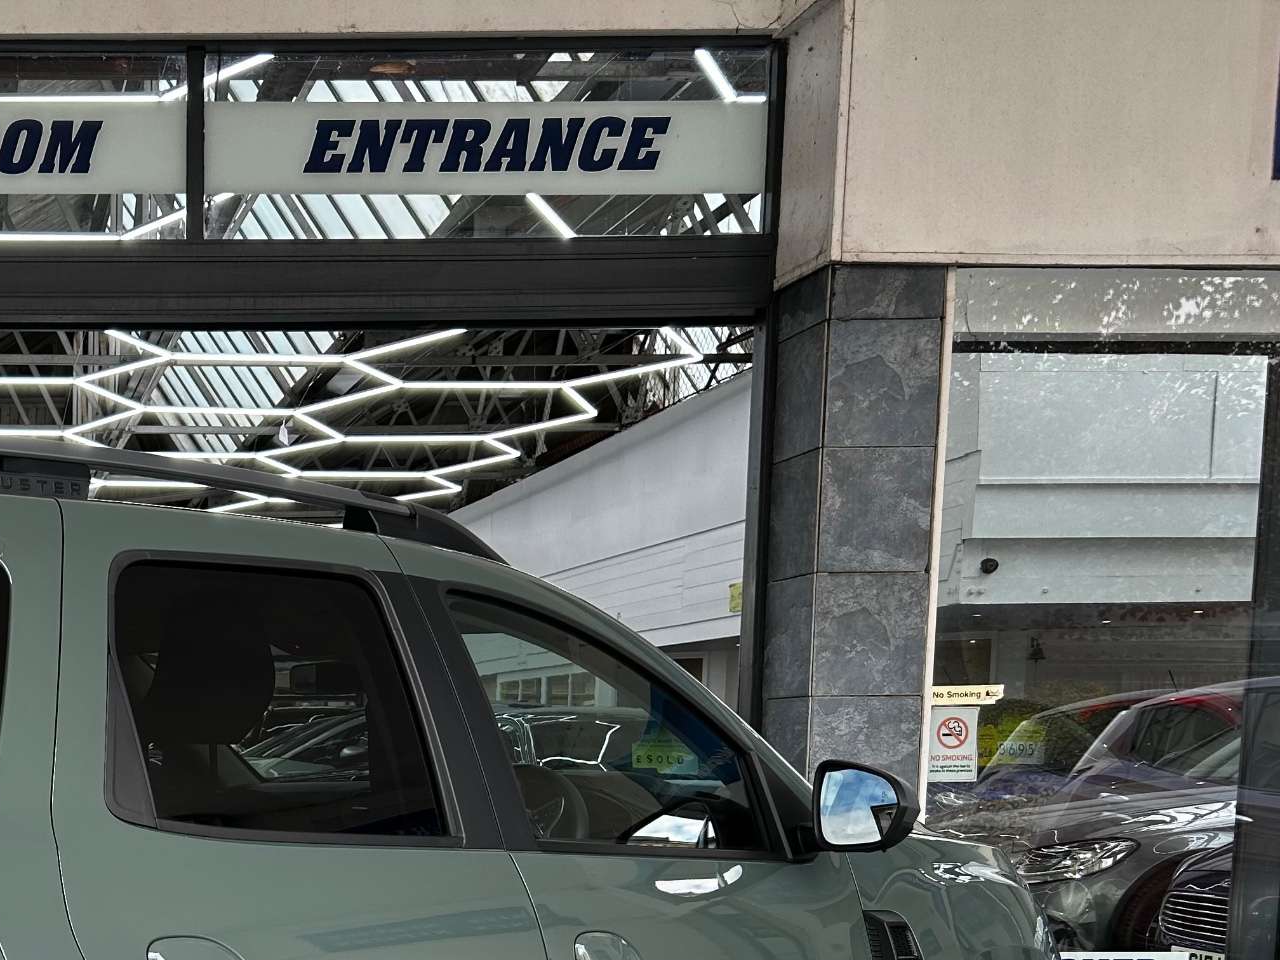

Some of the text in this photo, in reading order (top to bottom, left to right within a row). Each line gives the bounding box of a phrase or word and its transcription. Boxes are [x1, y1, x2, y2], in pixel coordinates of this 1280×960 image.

[303, 116, 671, 174] ENTRANCE
[932, 690, 982, 699] No Smoking
